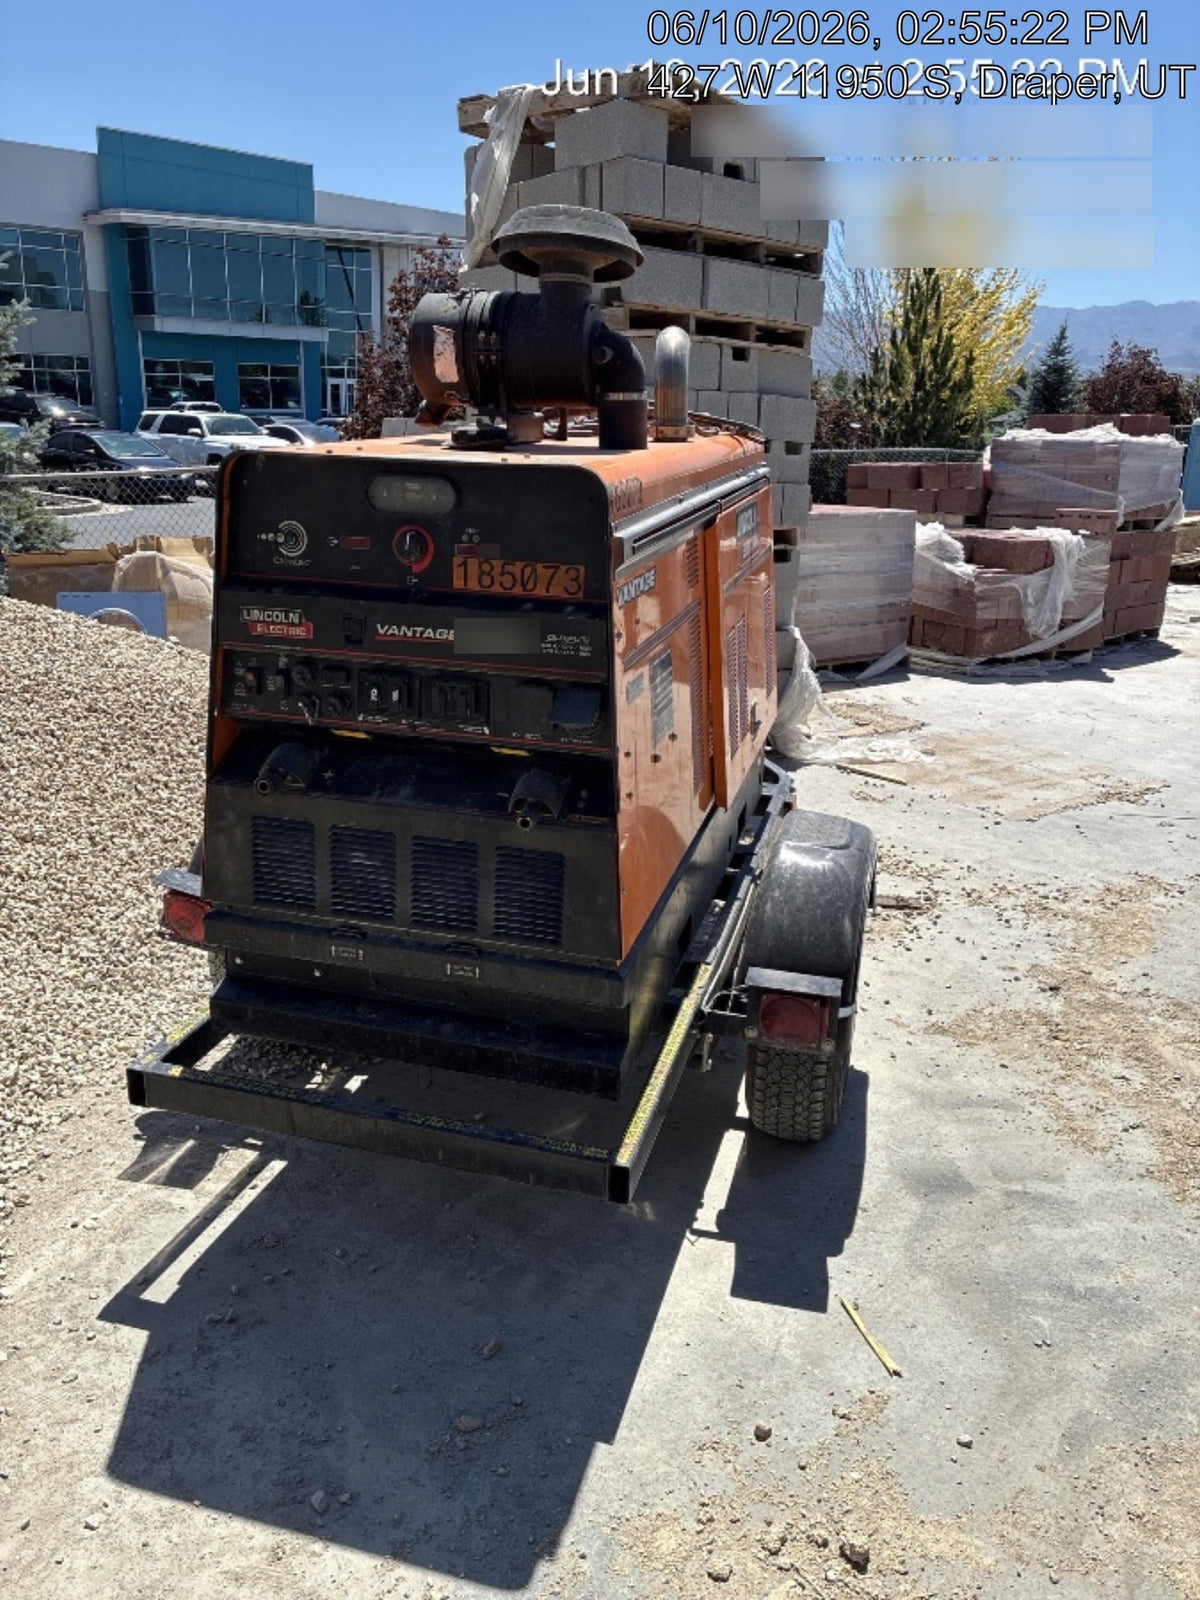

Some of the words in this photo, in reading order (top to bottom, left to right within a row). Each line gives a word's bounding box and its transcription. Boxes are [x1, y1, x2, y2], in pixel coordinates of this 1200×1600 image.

[455, 560, 582, 595] 185073
[243, 608, 300, 624] LINCOLN
[256, 623, 307, 636] ELECTRIC
